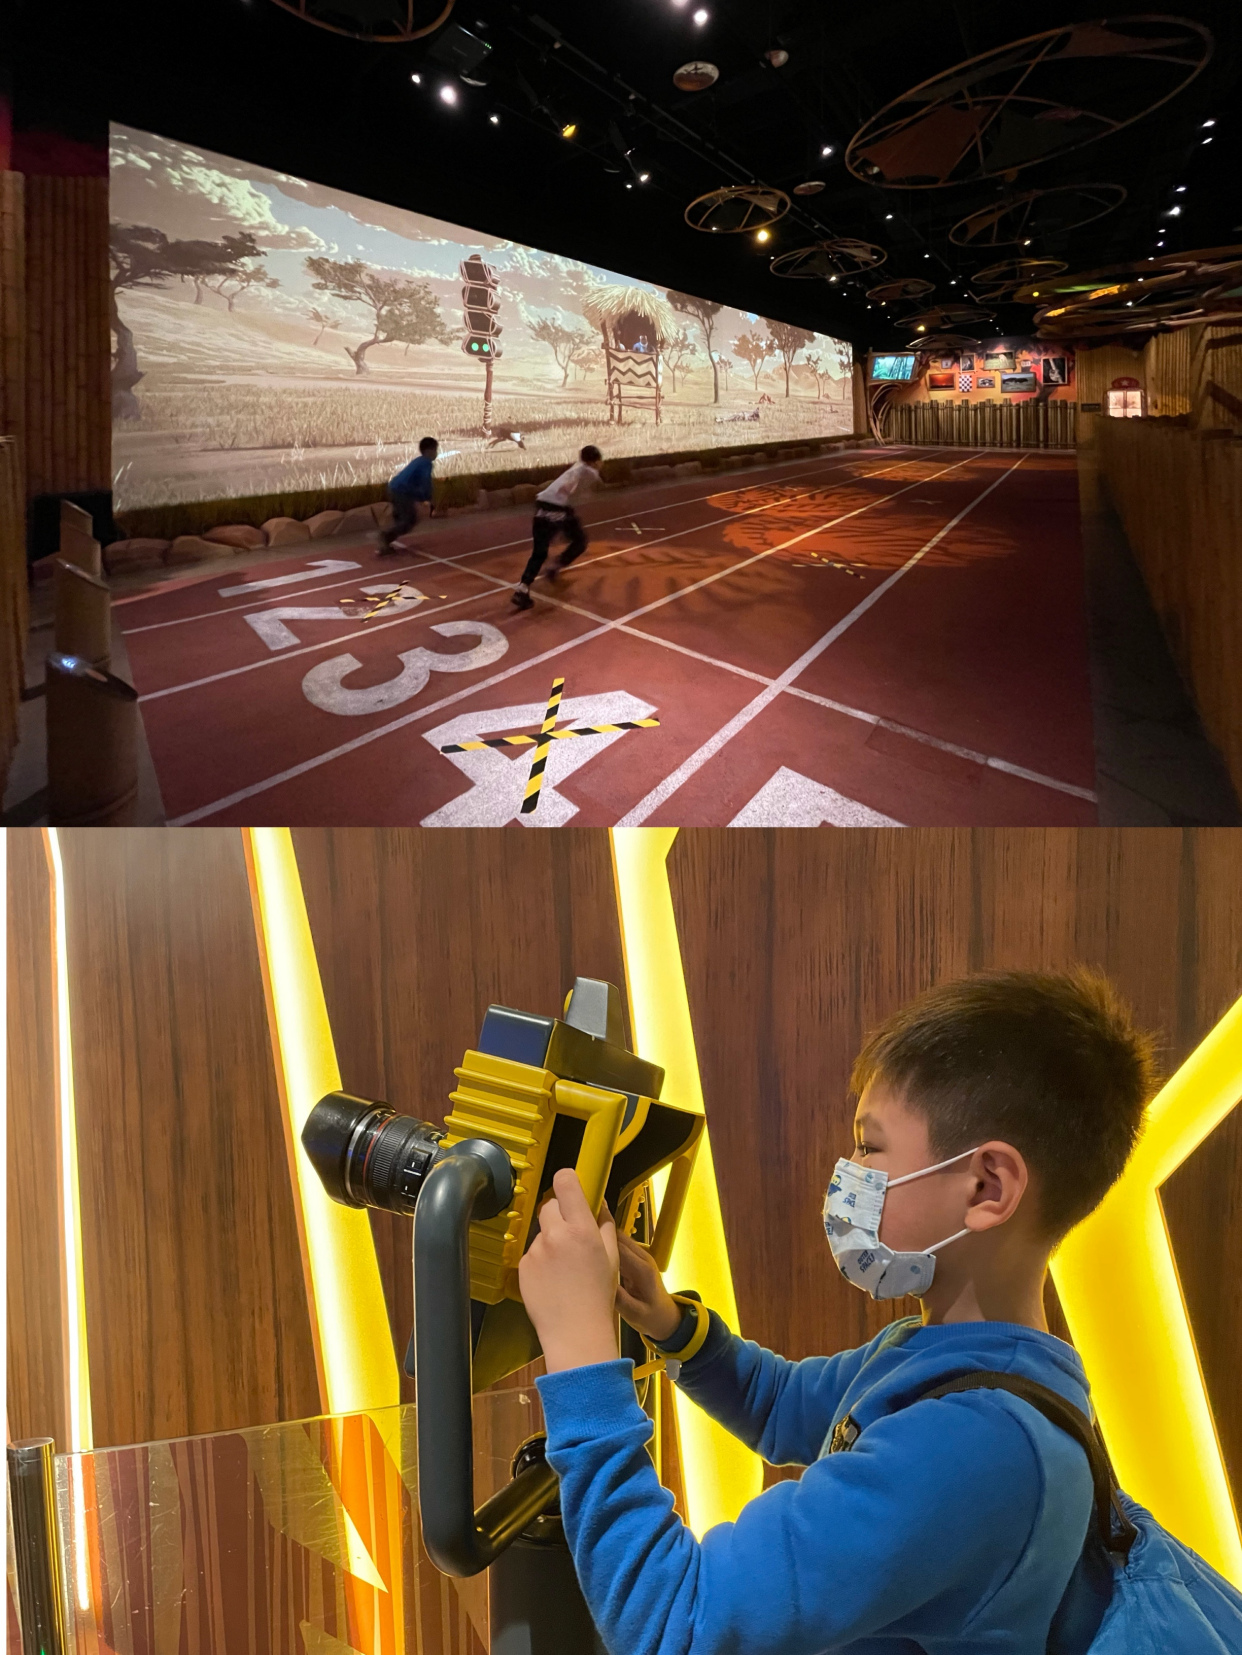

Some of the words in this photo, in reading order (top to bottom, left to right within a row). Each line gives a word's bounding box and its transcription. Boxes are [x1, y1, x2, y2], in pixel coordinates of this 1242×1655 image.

[217, 559, 362, 598] 1
[243, 583, 424, 651] 2
[302, 620, 509, 716] 3
[419, 690, 659, 827] 4
